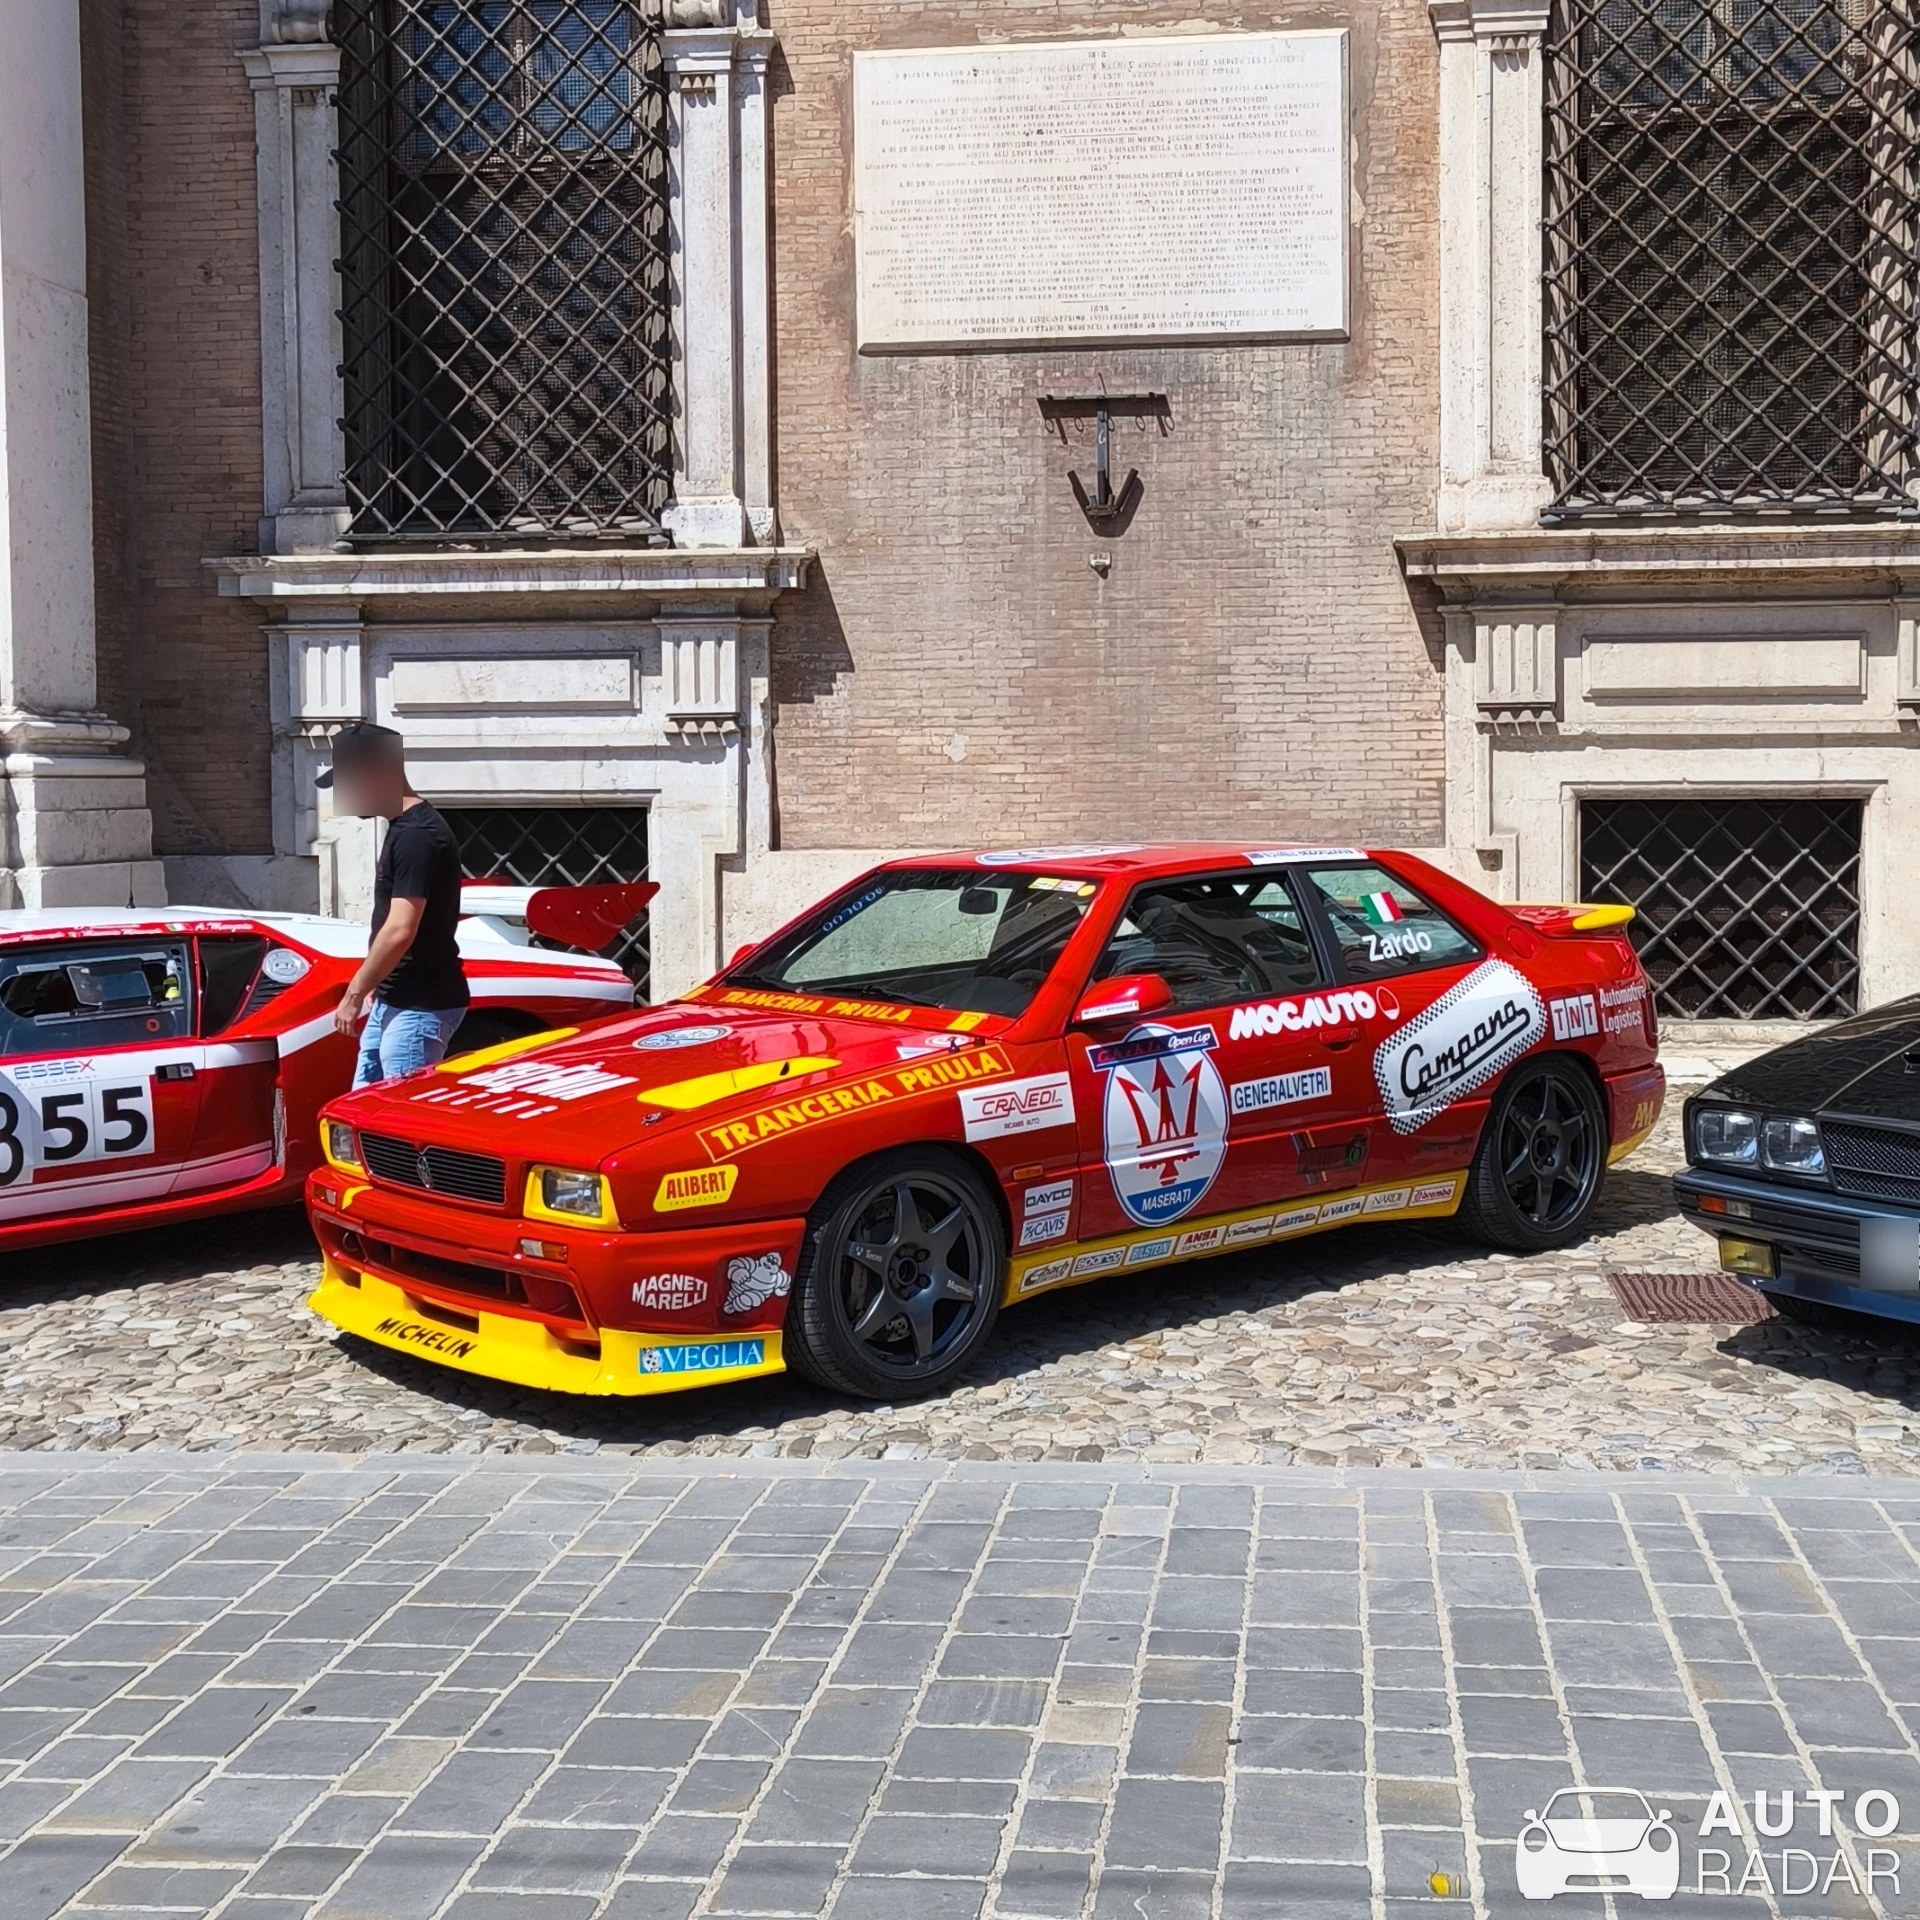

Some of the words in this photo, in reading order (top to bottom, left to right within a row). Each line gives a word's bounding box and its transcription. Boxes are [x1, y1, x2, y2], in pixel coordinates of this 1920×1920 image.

[1361, 927, 1432, 962] Zardo
[719, 991, 824, 1013] TRANCERIA
[829, 1002, 912, 1022] PRIULA
[1599, 981, 1646, 1009] Automotive
[1229, 991, 1376, 1041] MOCAUTO
[1554, 1003, 1593, 1032] TNT
[1602, 1007, 1642, 1034] Logistics
[1168, 1034, 1192, 1049] Open
[1193, 1031, 1211, 1044] Cup
[14, 1059, 96, 1080] ESSEX
[44, 1075, 98, 1084] COMPANY
[711, 1081, 894, 1151] TRANCERIA
[897, 1052, 1003, 1092] PRIULA
[1234, 1070, 1328, 1110] GENERALVETRI
[982, 1090, 1057, 1116] CRAVEDI
[1026, 1117, 1040, 1127] AUTO
[666, 1171, 726, 1200] ALIBERT
[1026, 1188, 1071, 1208] DAYCO
[1141, 1188, 1191, 1212] MASERATI
[1330, 1201, 1360, 1216] VARTA
[1372, 1192, 1403, 1206] NARDI
[1184, 1229, 1218, 1245] ANSA
[1131, 1241, 1169, 1260] BILSTEIN
[632, 1274, 708, 1298] MAGNETI
[632, 1288, 708, 1310] MARELLI
[374, 1317, 478, 1359] MICHELIN
[663, 1342, 763, 1370] VEGLIA
